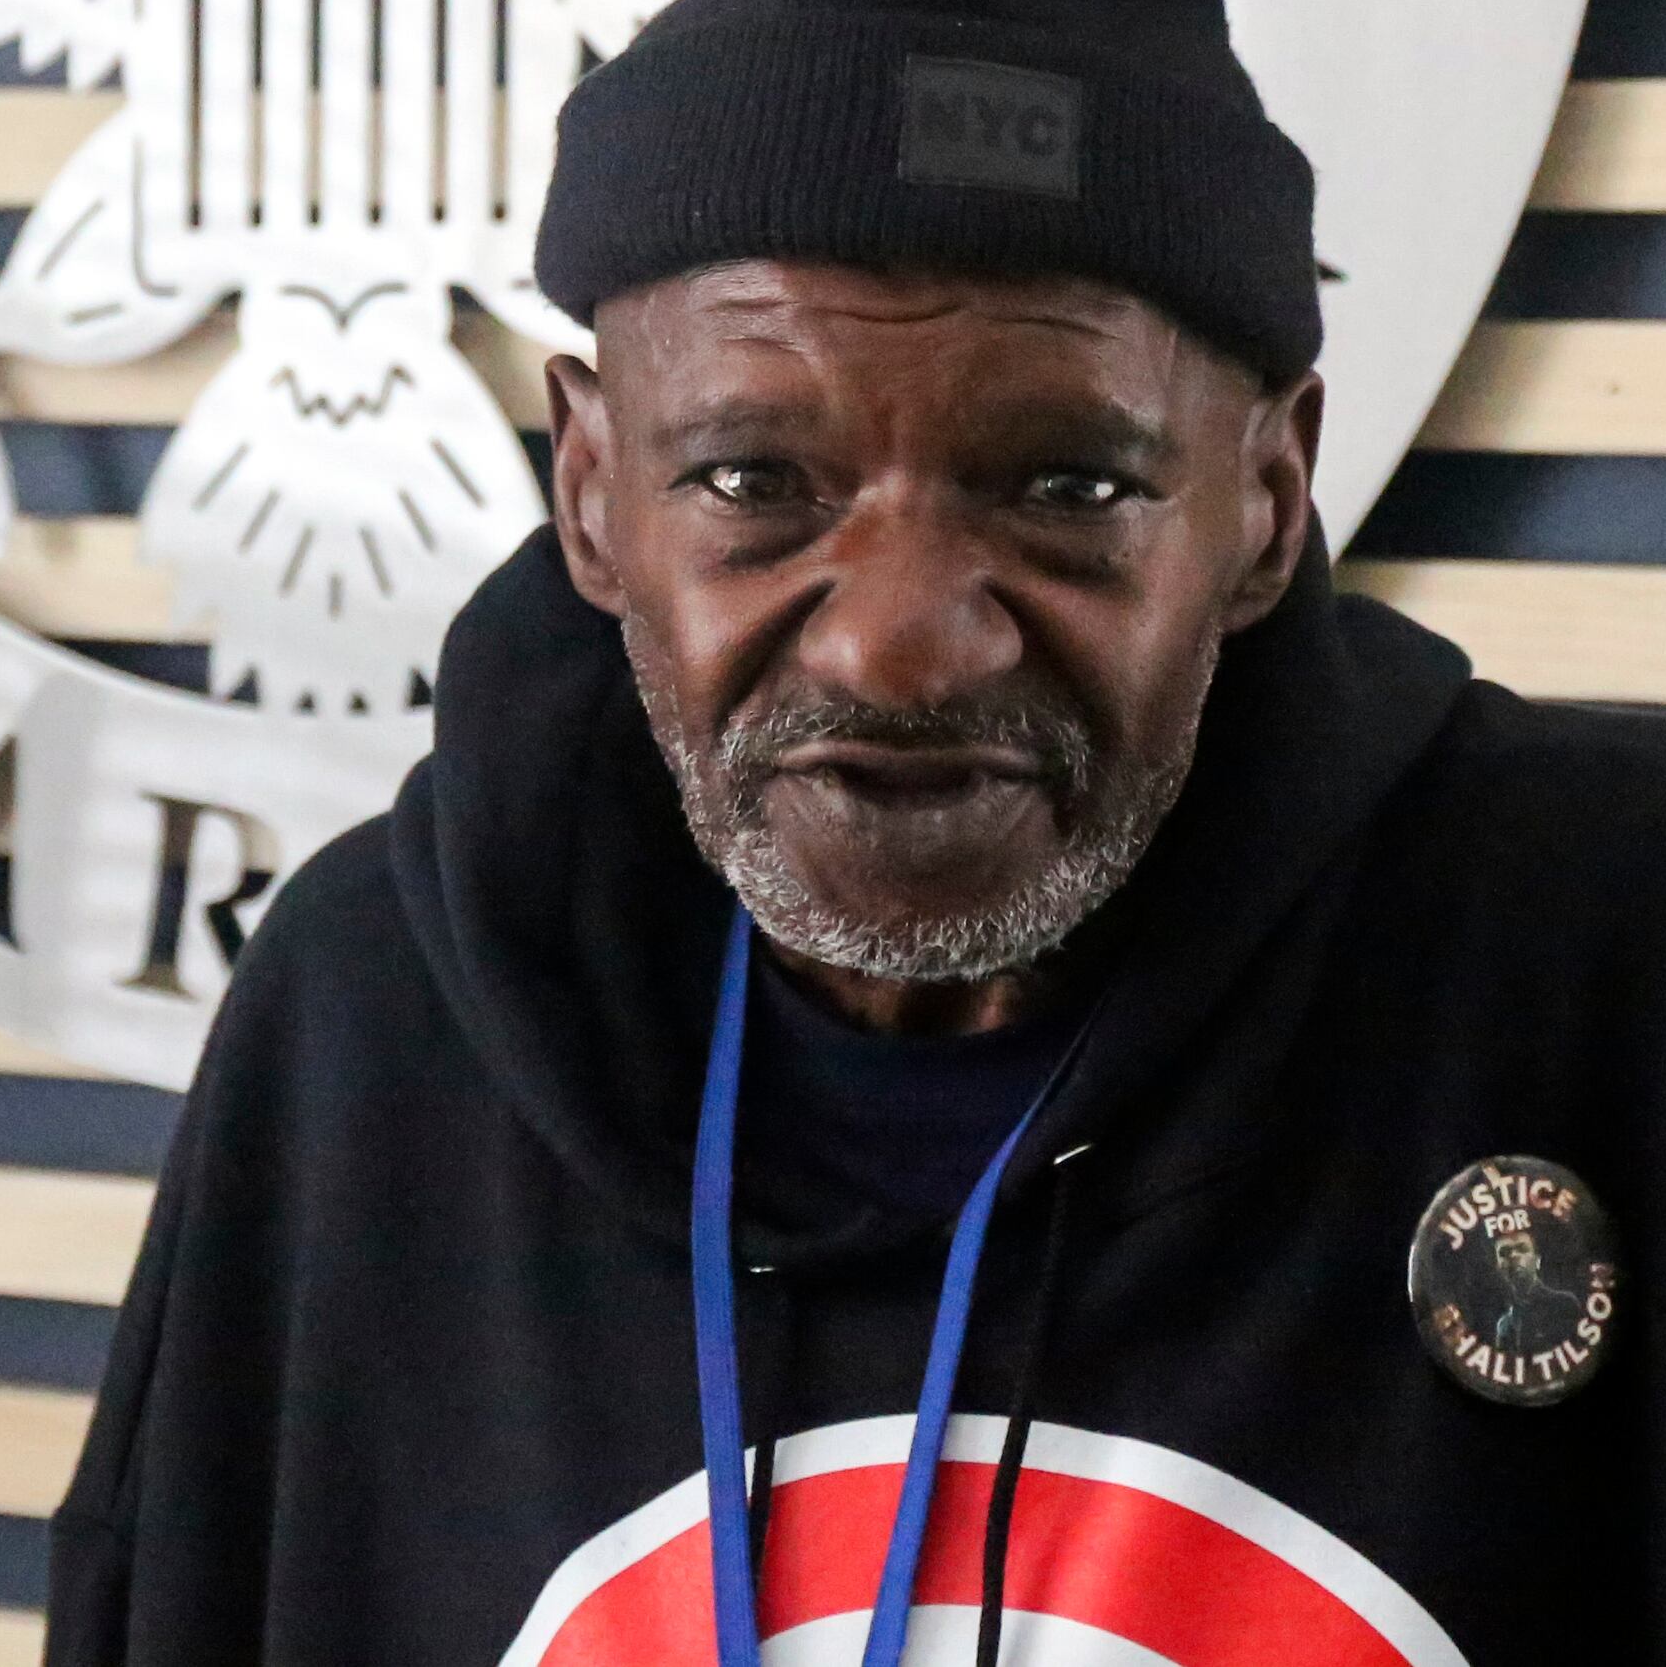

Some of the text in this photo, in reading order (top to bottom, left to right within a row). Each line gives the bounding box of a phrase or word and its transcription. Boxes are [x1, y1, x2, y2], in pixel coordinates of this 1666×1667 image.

[919, 91, 1065, 157] NYC
[1439, 1175, 1579, 1251] JUSTICE
[1485, 1208, 1532, 1239] FOR
[1434, 1262, 1616, 1384] HALI TILSON
